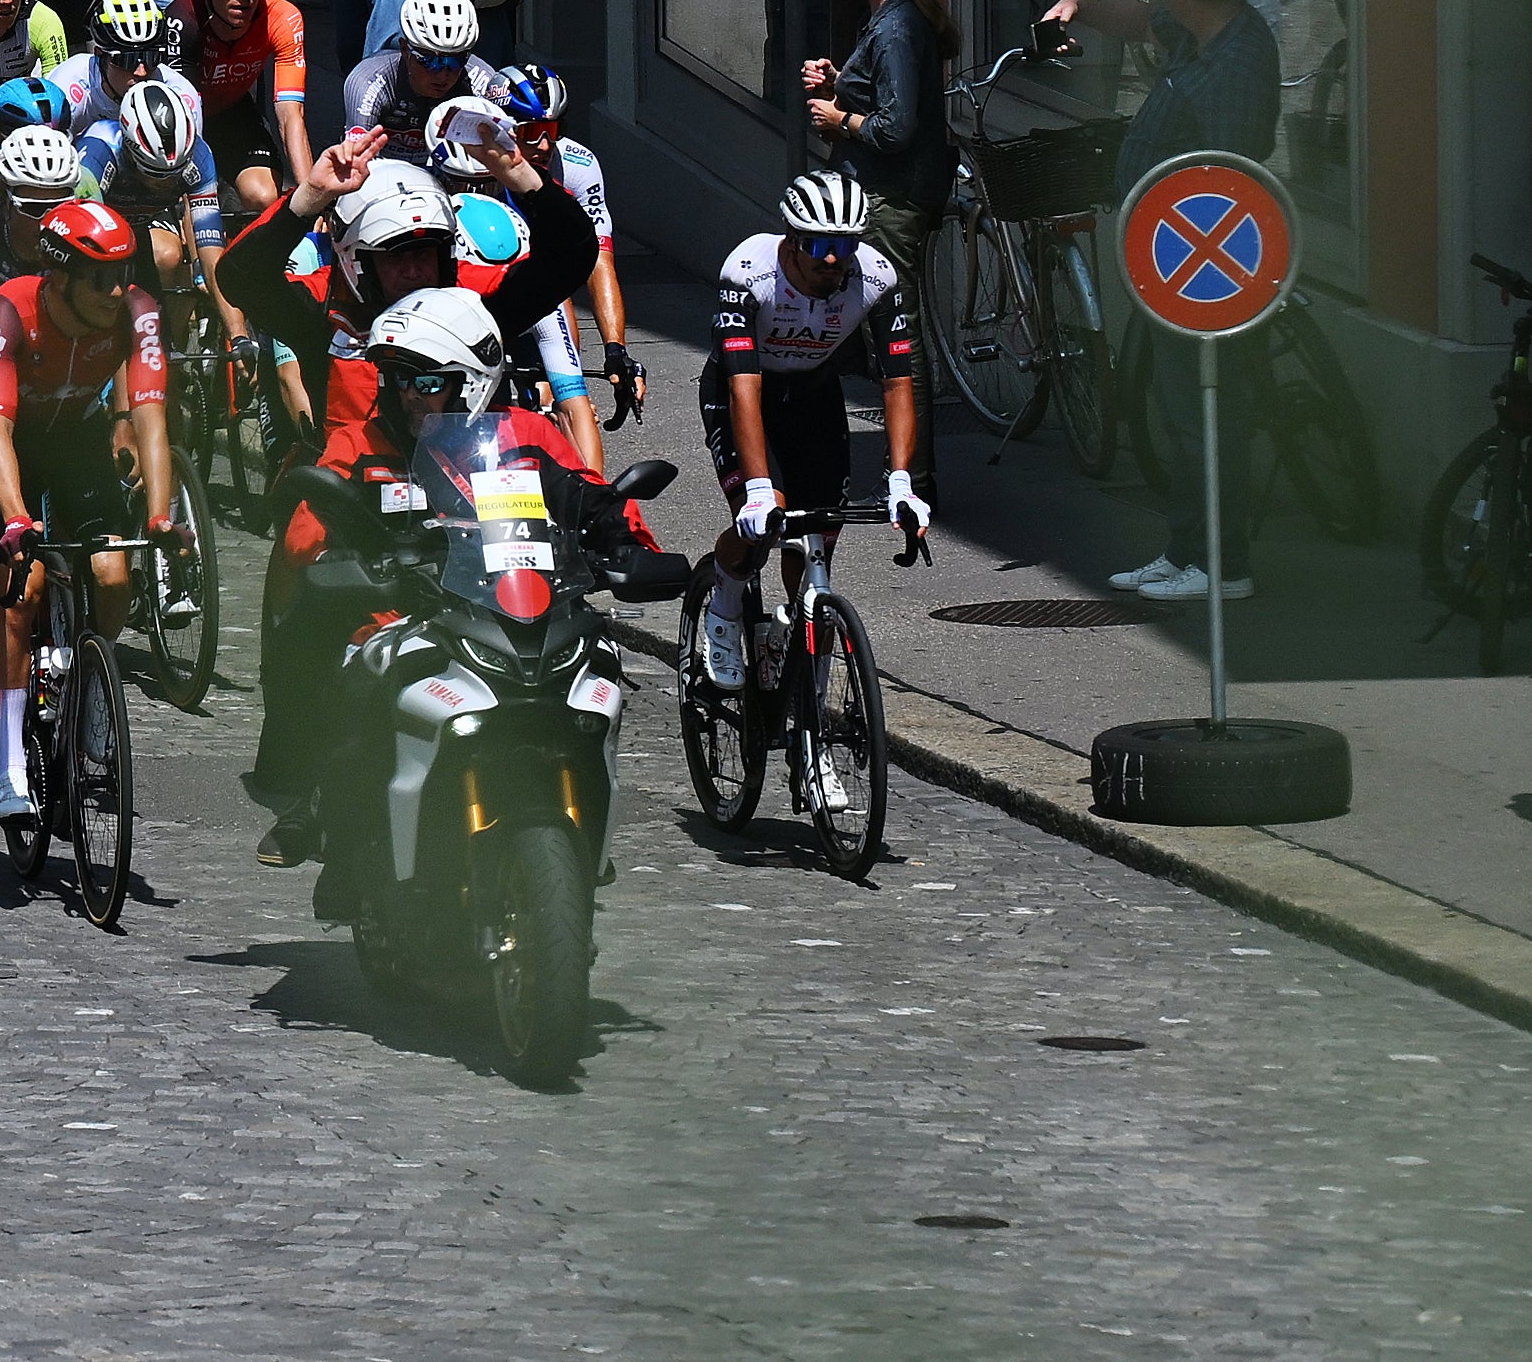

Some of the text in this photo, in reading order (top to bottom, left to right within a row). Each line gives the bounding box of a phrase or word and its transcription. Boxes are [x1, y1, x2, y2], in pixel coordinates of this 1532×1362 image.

[565, 144, 596, 160] BORA
[584, 183, 606, 227] BOSS
[499, 522, 531, 539] 74
[423, 679, 464, 708] YAMAHA
